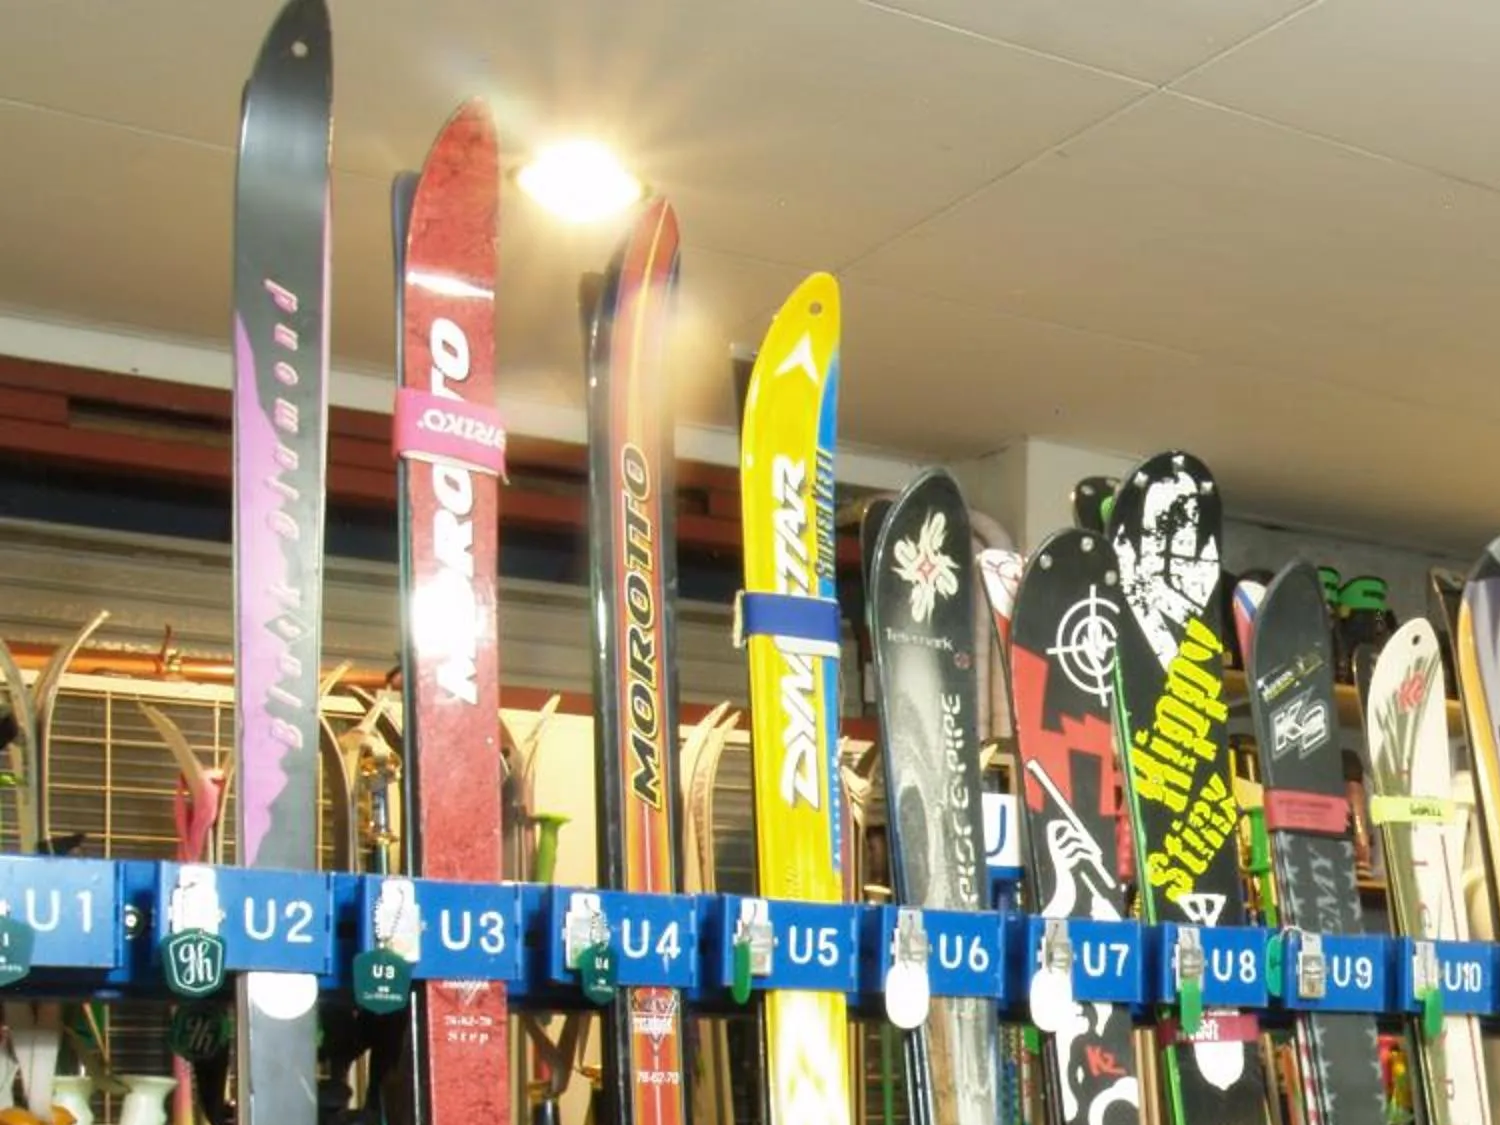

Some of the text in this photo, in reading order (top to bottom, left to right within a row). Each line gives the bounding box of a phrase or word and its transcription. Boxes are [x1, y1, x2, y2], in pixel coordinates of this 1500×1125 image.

[621, 443, 667, 811] MOROTTO
[772, 455, 821, 811] DYNTAR
[1130, 616, 1229, 815] Hippy
[1271, 694, 1329, 757] K2
[1307, 842, 1344, 932] EMY
[26, 889, 93, 934] U1
[244, 898, 314, 944] U2
[440, 909, 506, 954] U3
[620, 917, 681, 961] U4
[787, 926, 840, 968] U5
[938, 933, 990, 973] U6
[1081, 940, 1131, 978] U7
[1210, 946, 1257, 984] U8
[1331, 953, 1374, 990] U9
[1444, 960, 1482, 994] U10
